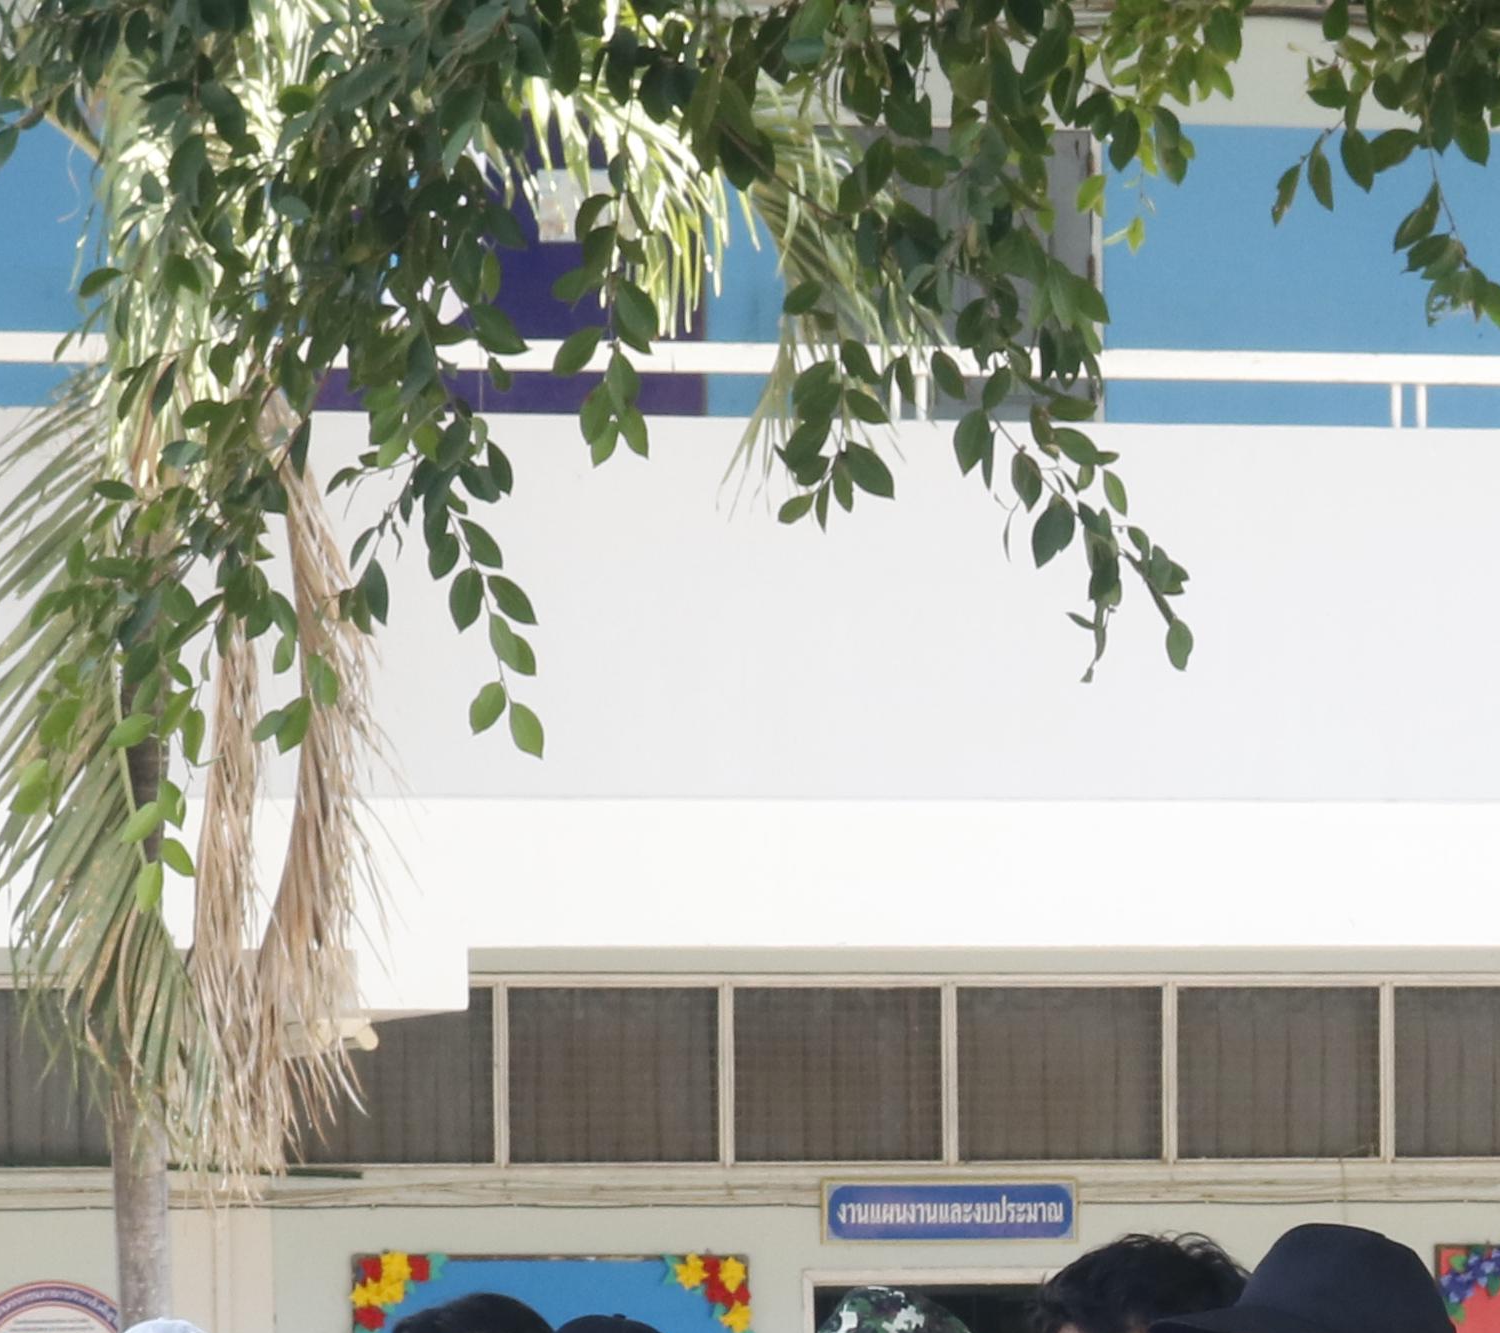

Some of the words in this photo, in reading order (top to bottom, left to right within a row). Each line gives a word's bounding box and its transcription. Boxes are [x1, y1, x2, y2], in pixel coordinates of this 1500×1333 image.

[837, 1195, 1064, 1226] งานแผนงานและงบประมาณ
